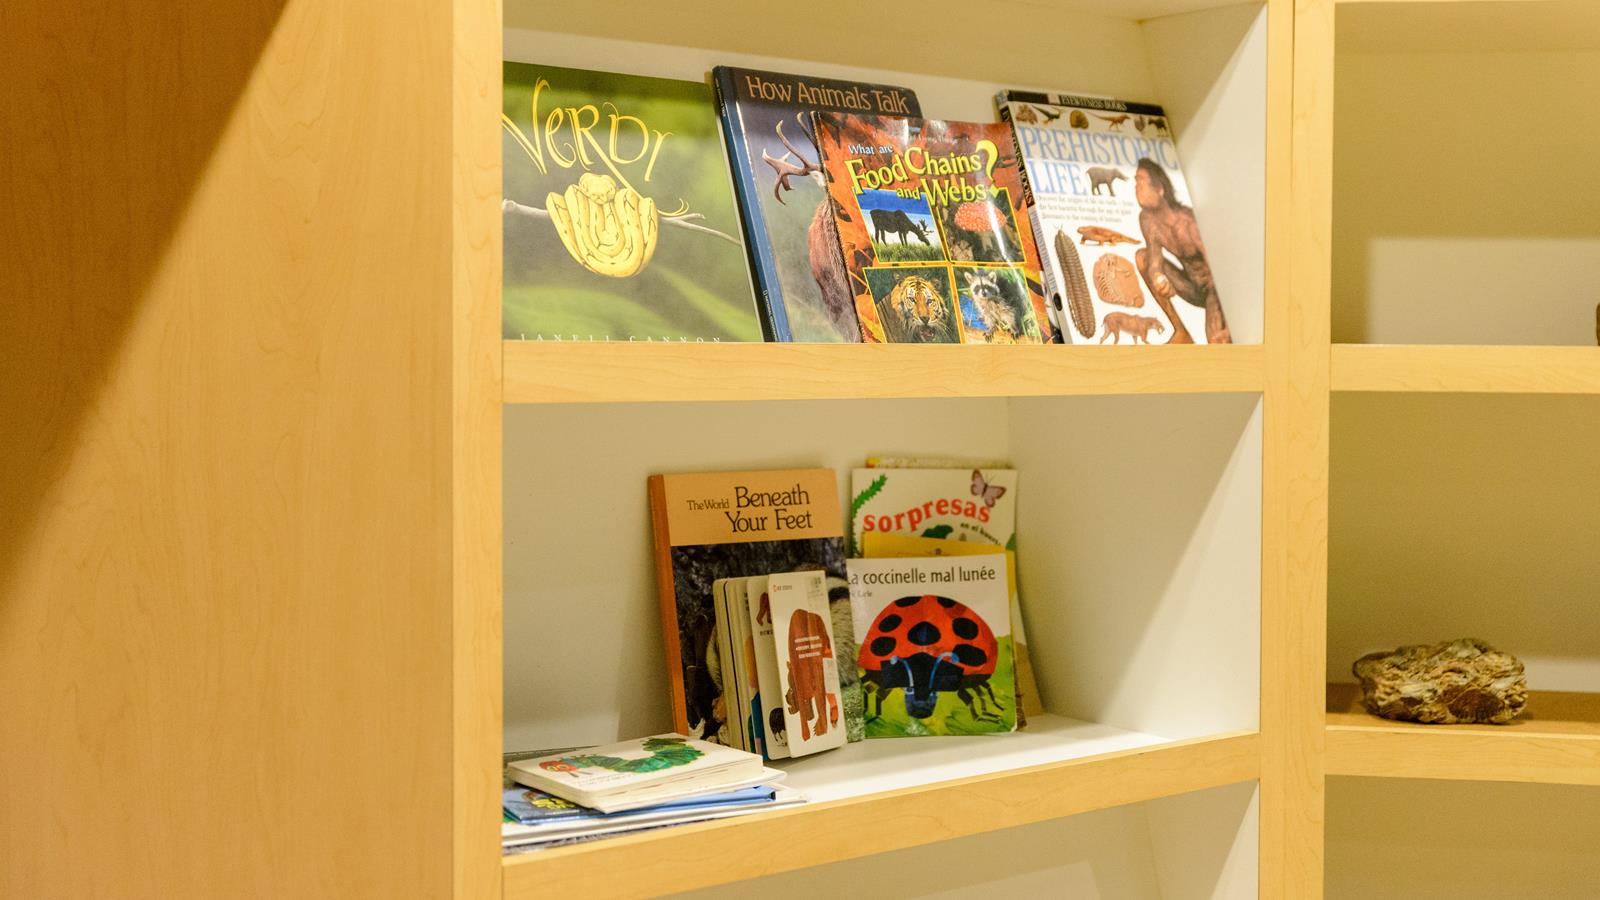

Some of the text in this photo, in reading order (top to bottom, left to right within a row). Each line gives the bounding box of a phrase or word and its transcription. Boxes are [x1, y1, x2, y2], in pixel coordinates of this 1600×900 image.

[745, 75, 792, 102] How
[798, 82, 871, 111] Animals
[875, 91, 911, 114] Talk
[848, 143, 894, 155] What are
[1019, 126, 1179, 170] PREHISTORIC
[844, 153, 909, 195] Food
[1027, 160, 1089, 196] LIFE
[896, 177, 987, 207] and Webs
[687, 484, 810, 511] The World Beneath
[724, 508, 813, 533] Your Feet
[863, 498, 991, 533] sorpresas
[863, 567, 926, 585] coccinelle
[931, 566, 955, 583] mal
[959, 565, 996, 583] lunée
